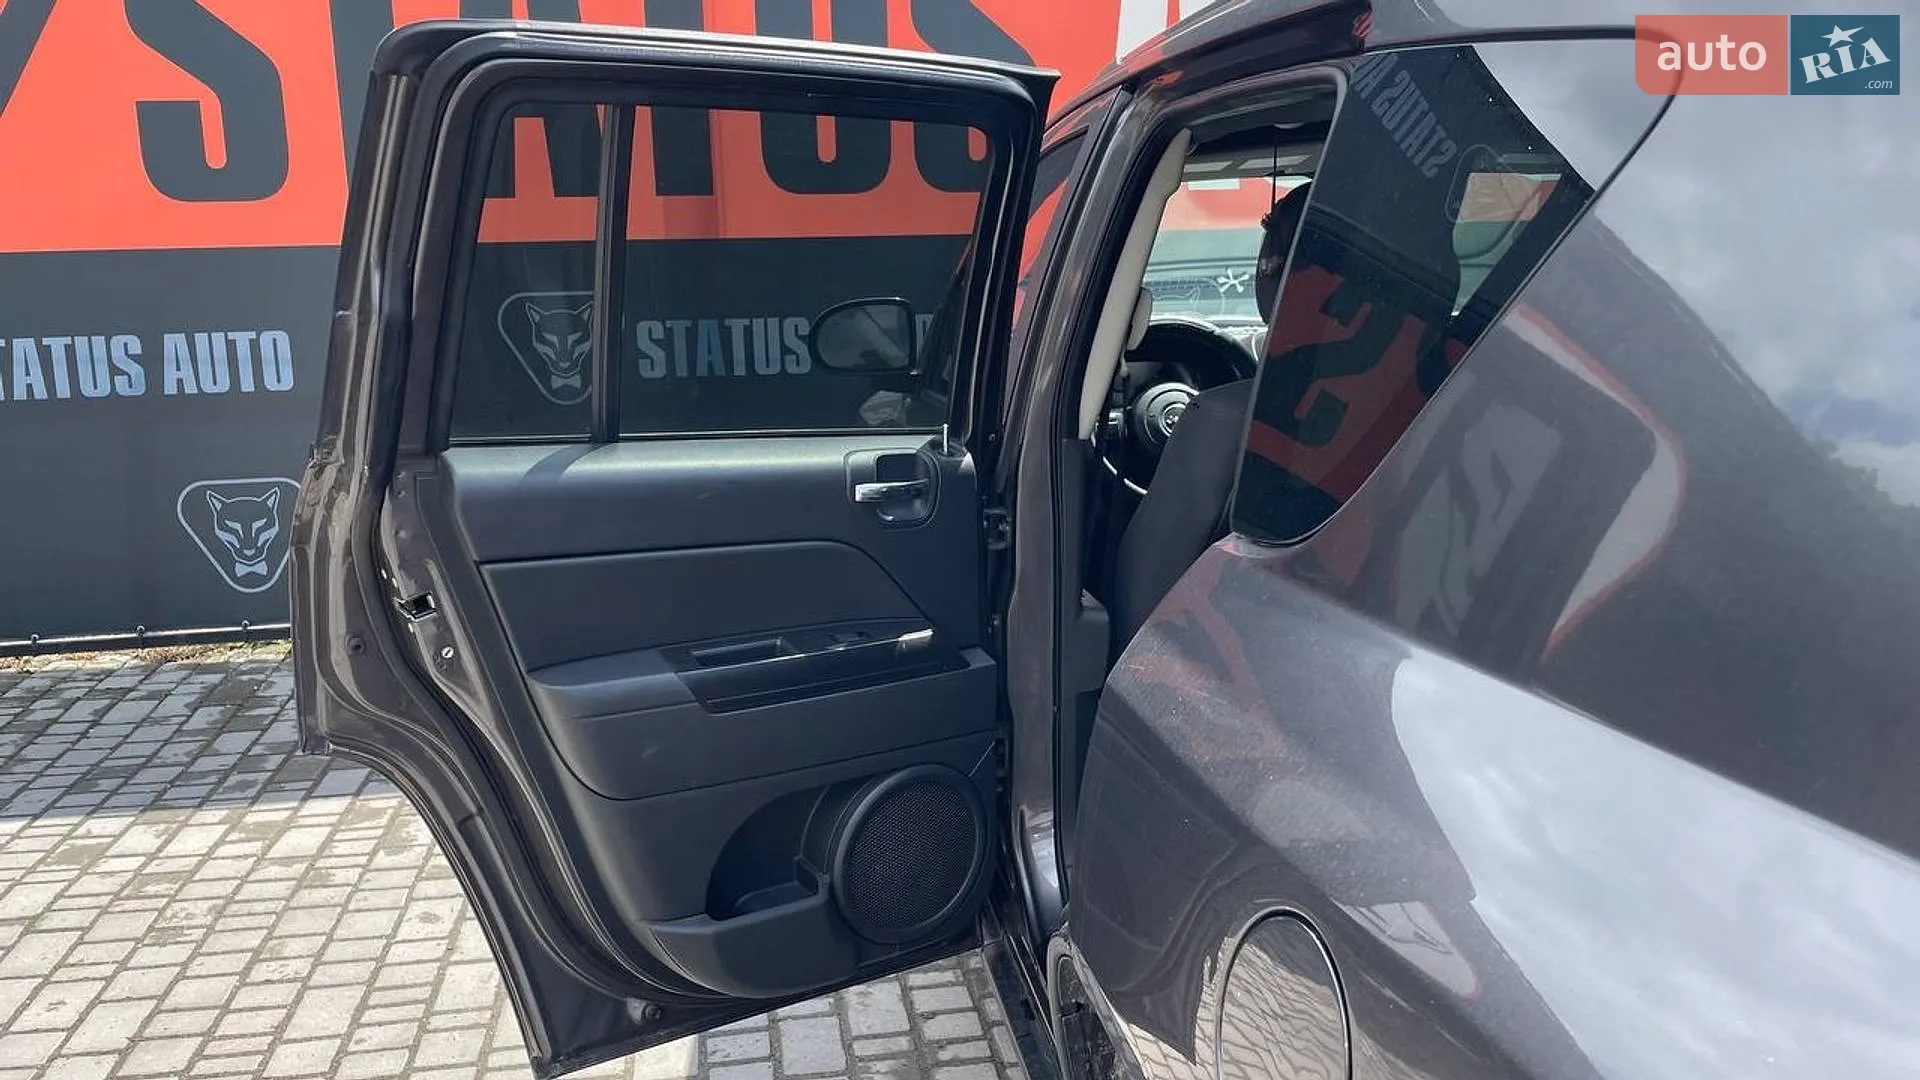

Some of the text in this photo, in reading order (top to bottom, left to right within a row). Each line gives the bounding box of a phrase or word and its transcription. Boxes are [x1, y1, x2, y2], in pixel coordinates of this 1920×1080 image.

[0, 330, 294, 401] ATUS AUTO
[635, 316, 812, 379] STATUS
